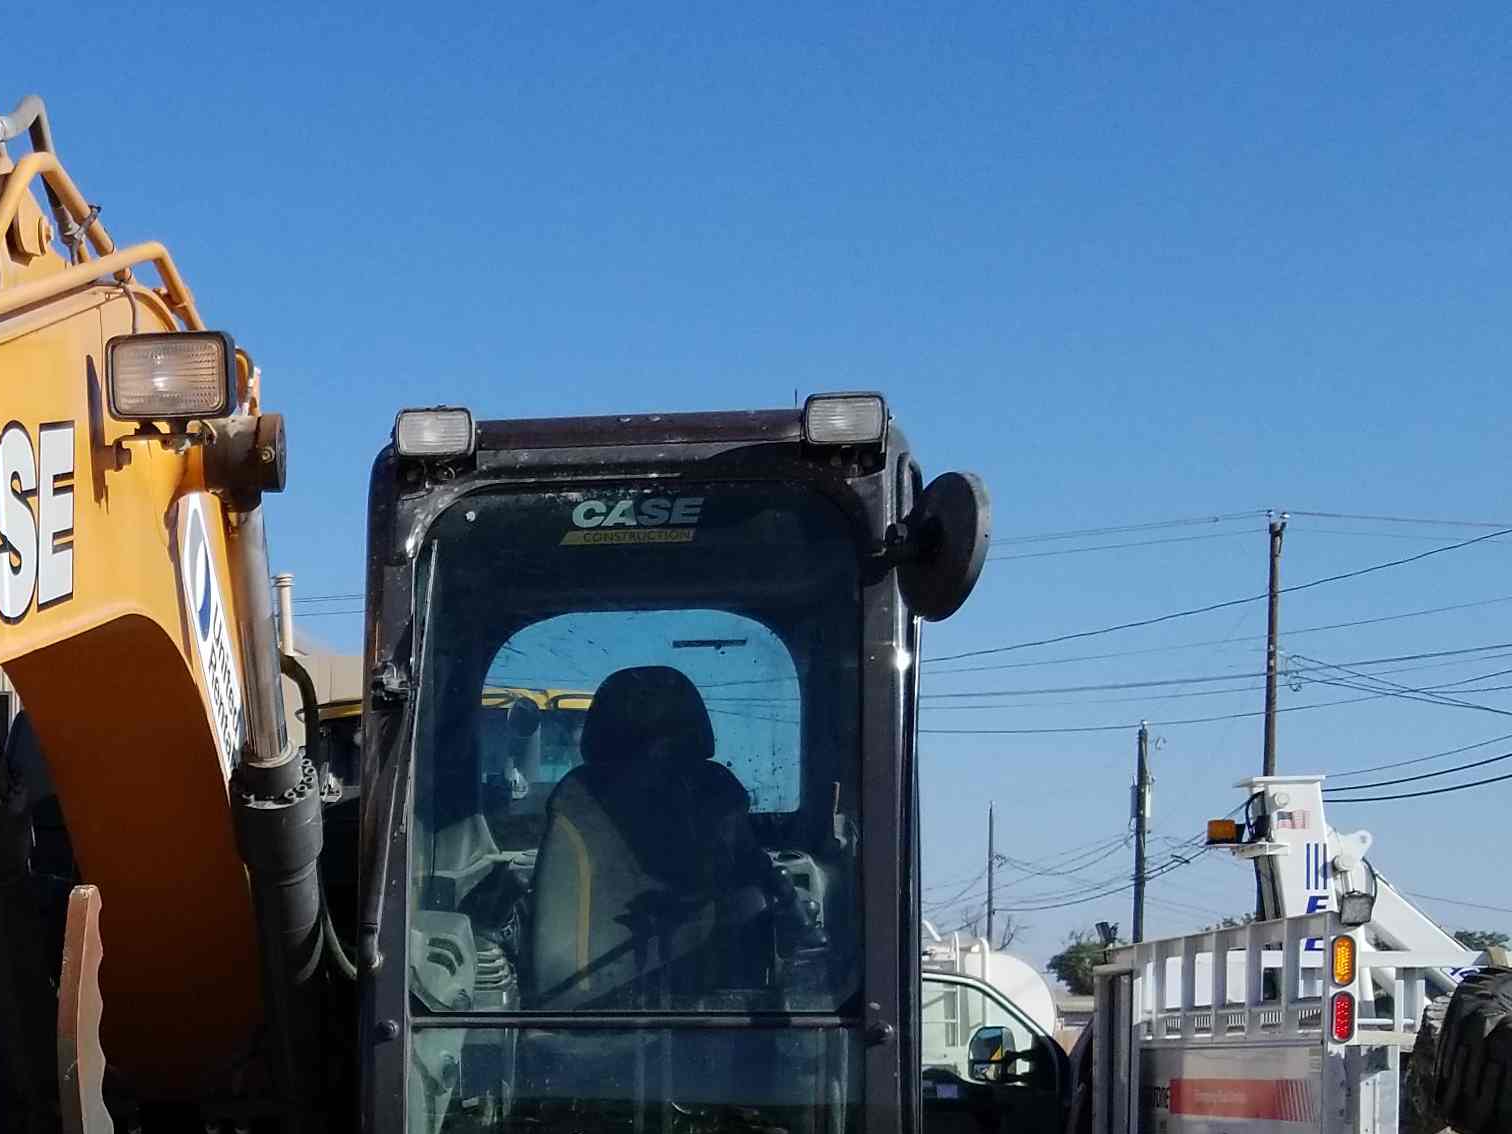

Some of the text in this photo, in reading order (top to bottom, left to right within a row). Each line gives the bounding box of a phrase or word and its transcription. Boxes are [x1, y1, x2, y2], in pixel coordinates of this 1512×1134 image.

[572, 497, 704, 528] CASE
[582, 530, 693, 544] CONSTRUCTION
[208, 643, 232, 760] Renta
[212, 600, 240, 734] United
